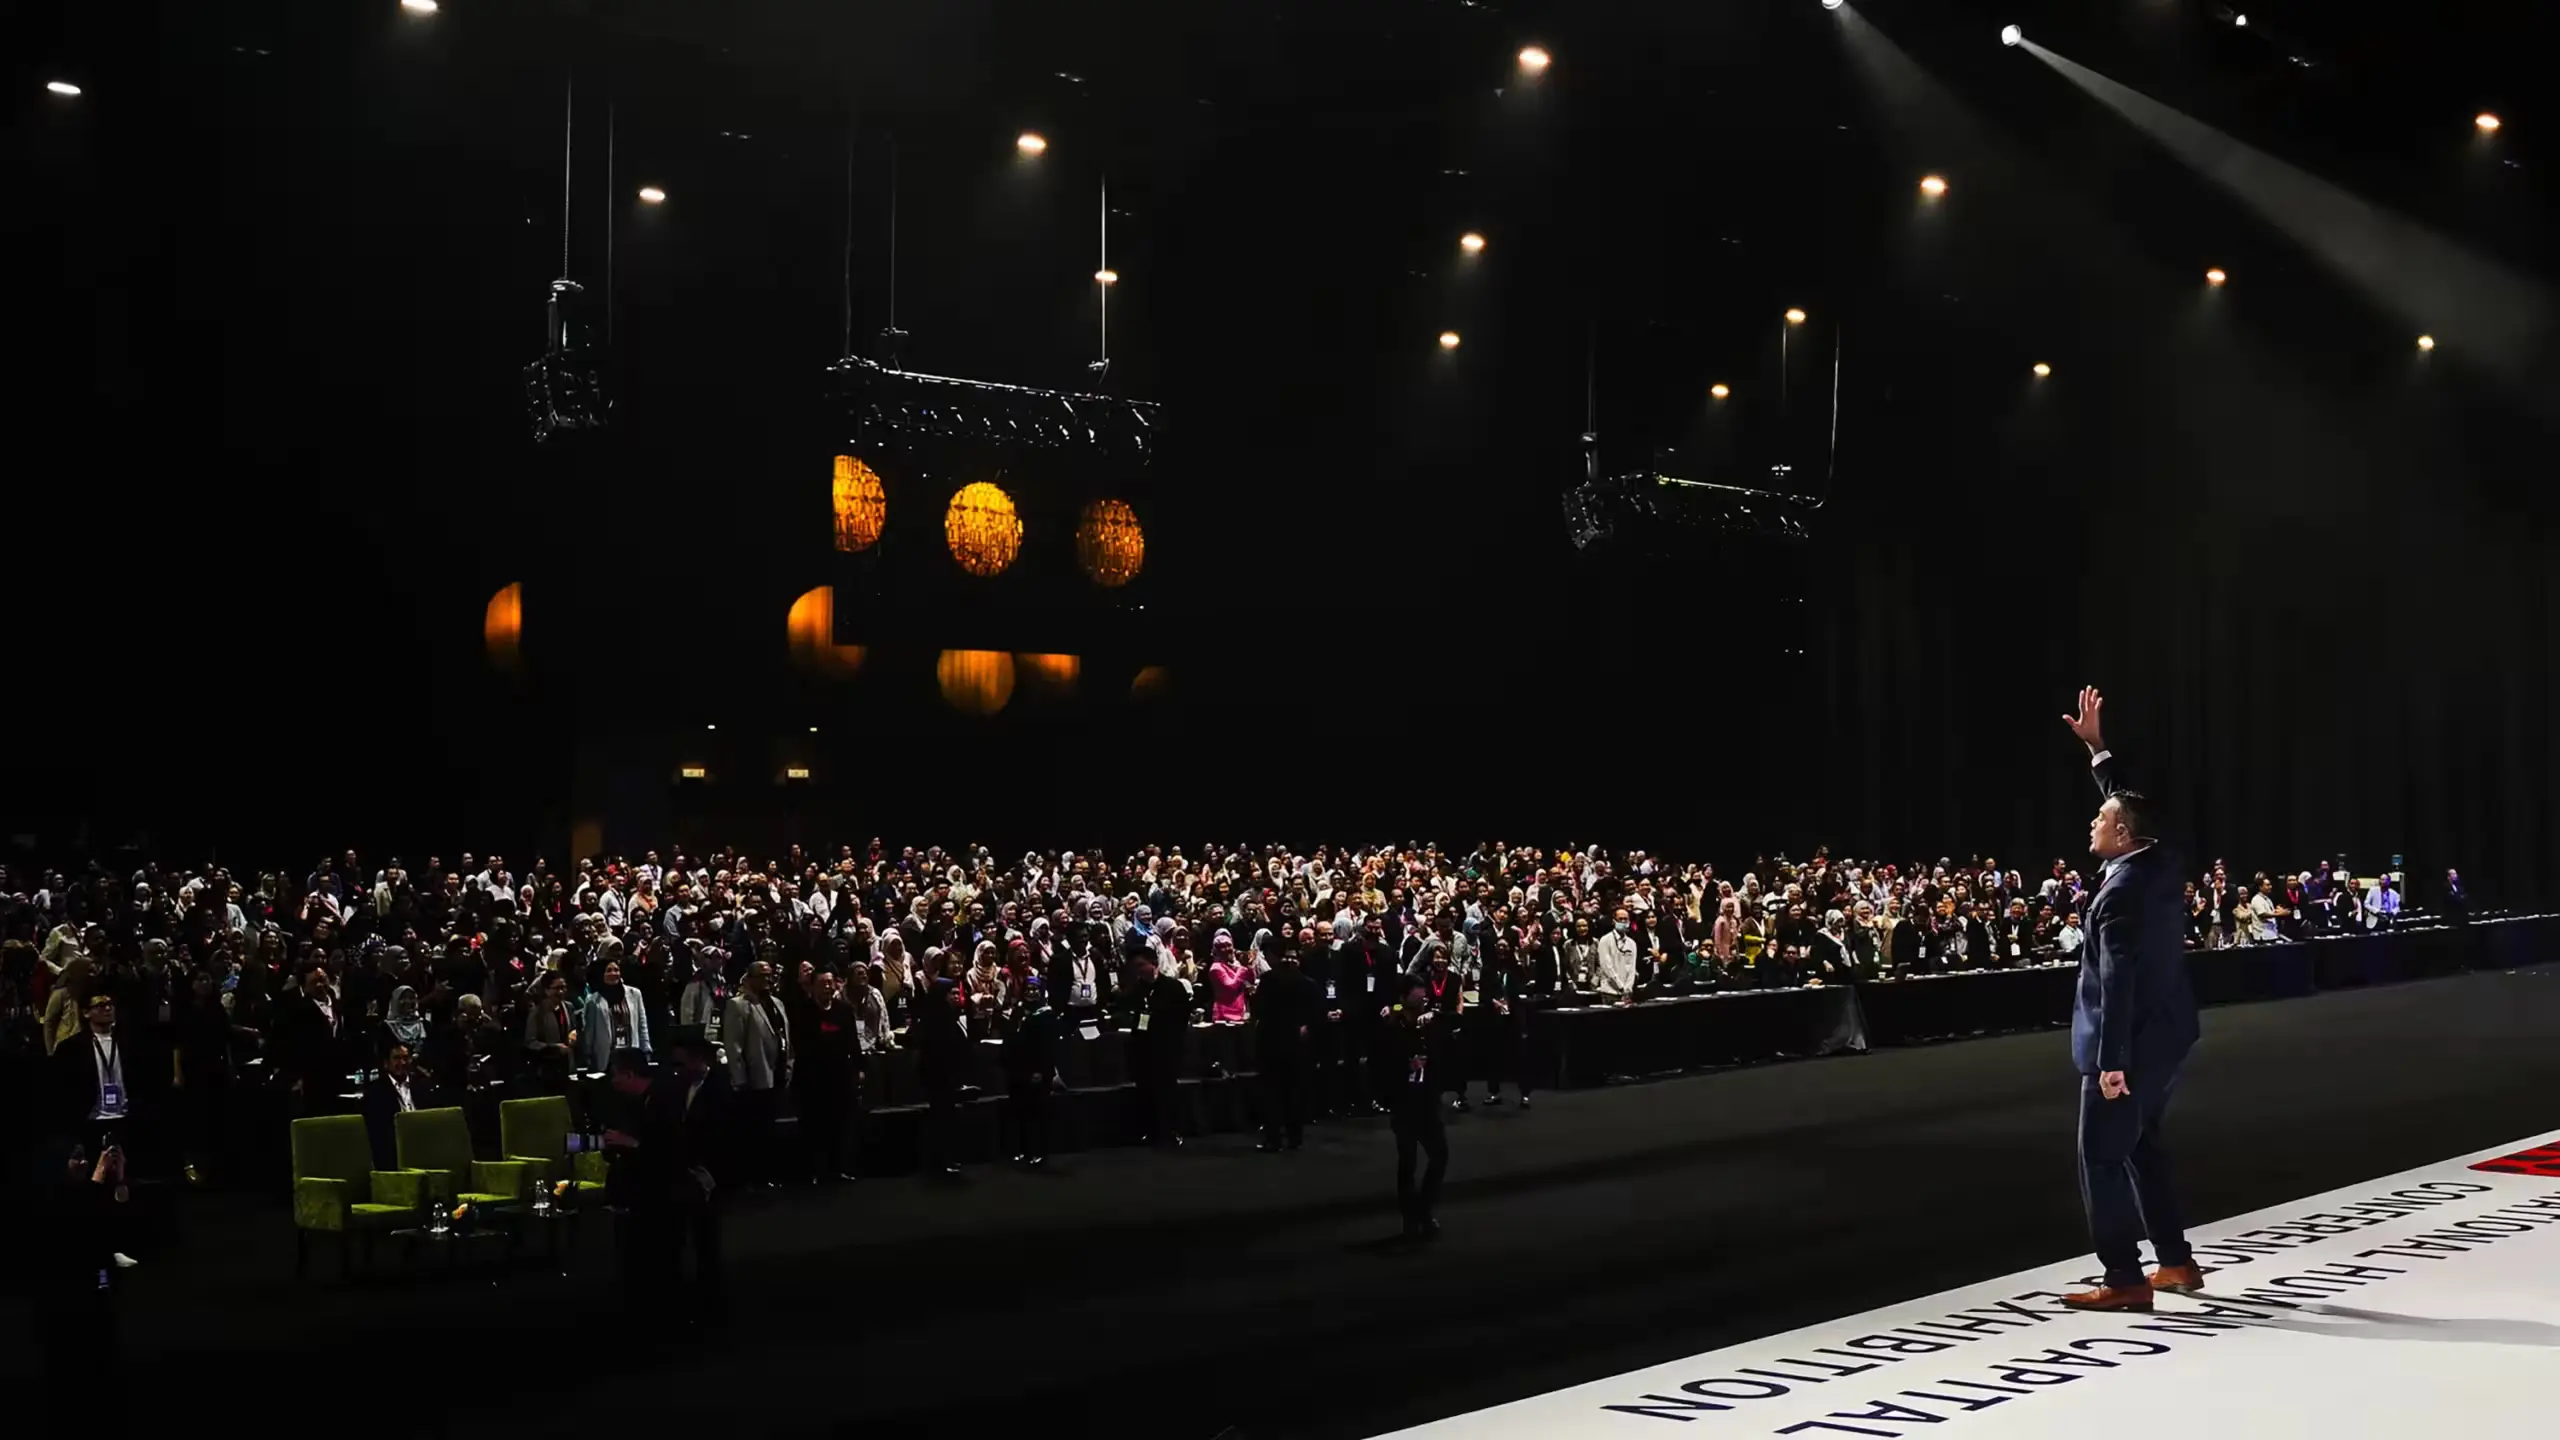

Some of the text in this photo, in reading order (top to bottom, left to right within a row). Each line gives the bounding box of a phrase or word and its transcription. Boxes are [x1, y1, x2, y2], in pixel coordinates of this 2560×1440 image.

[1773, 1191, 2560, 1438] ATIONAL HUMAN CAPITAL
